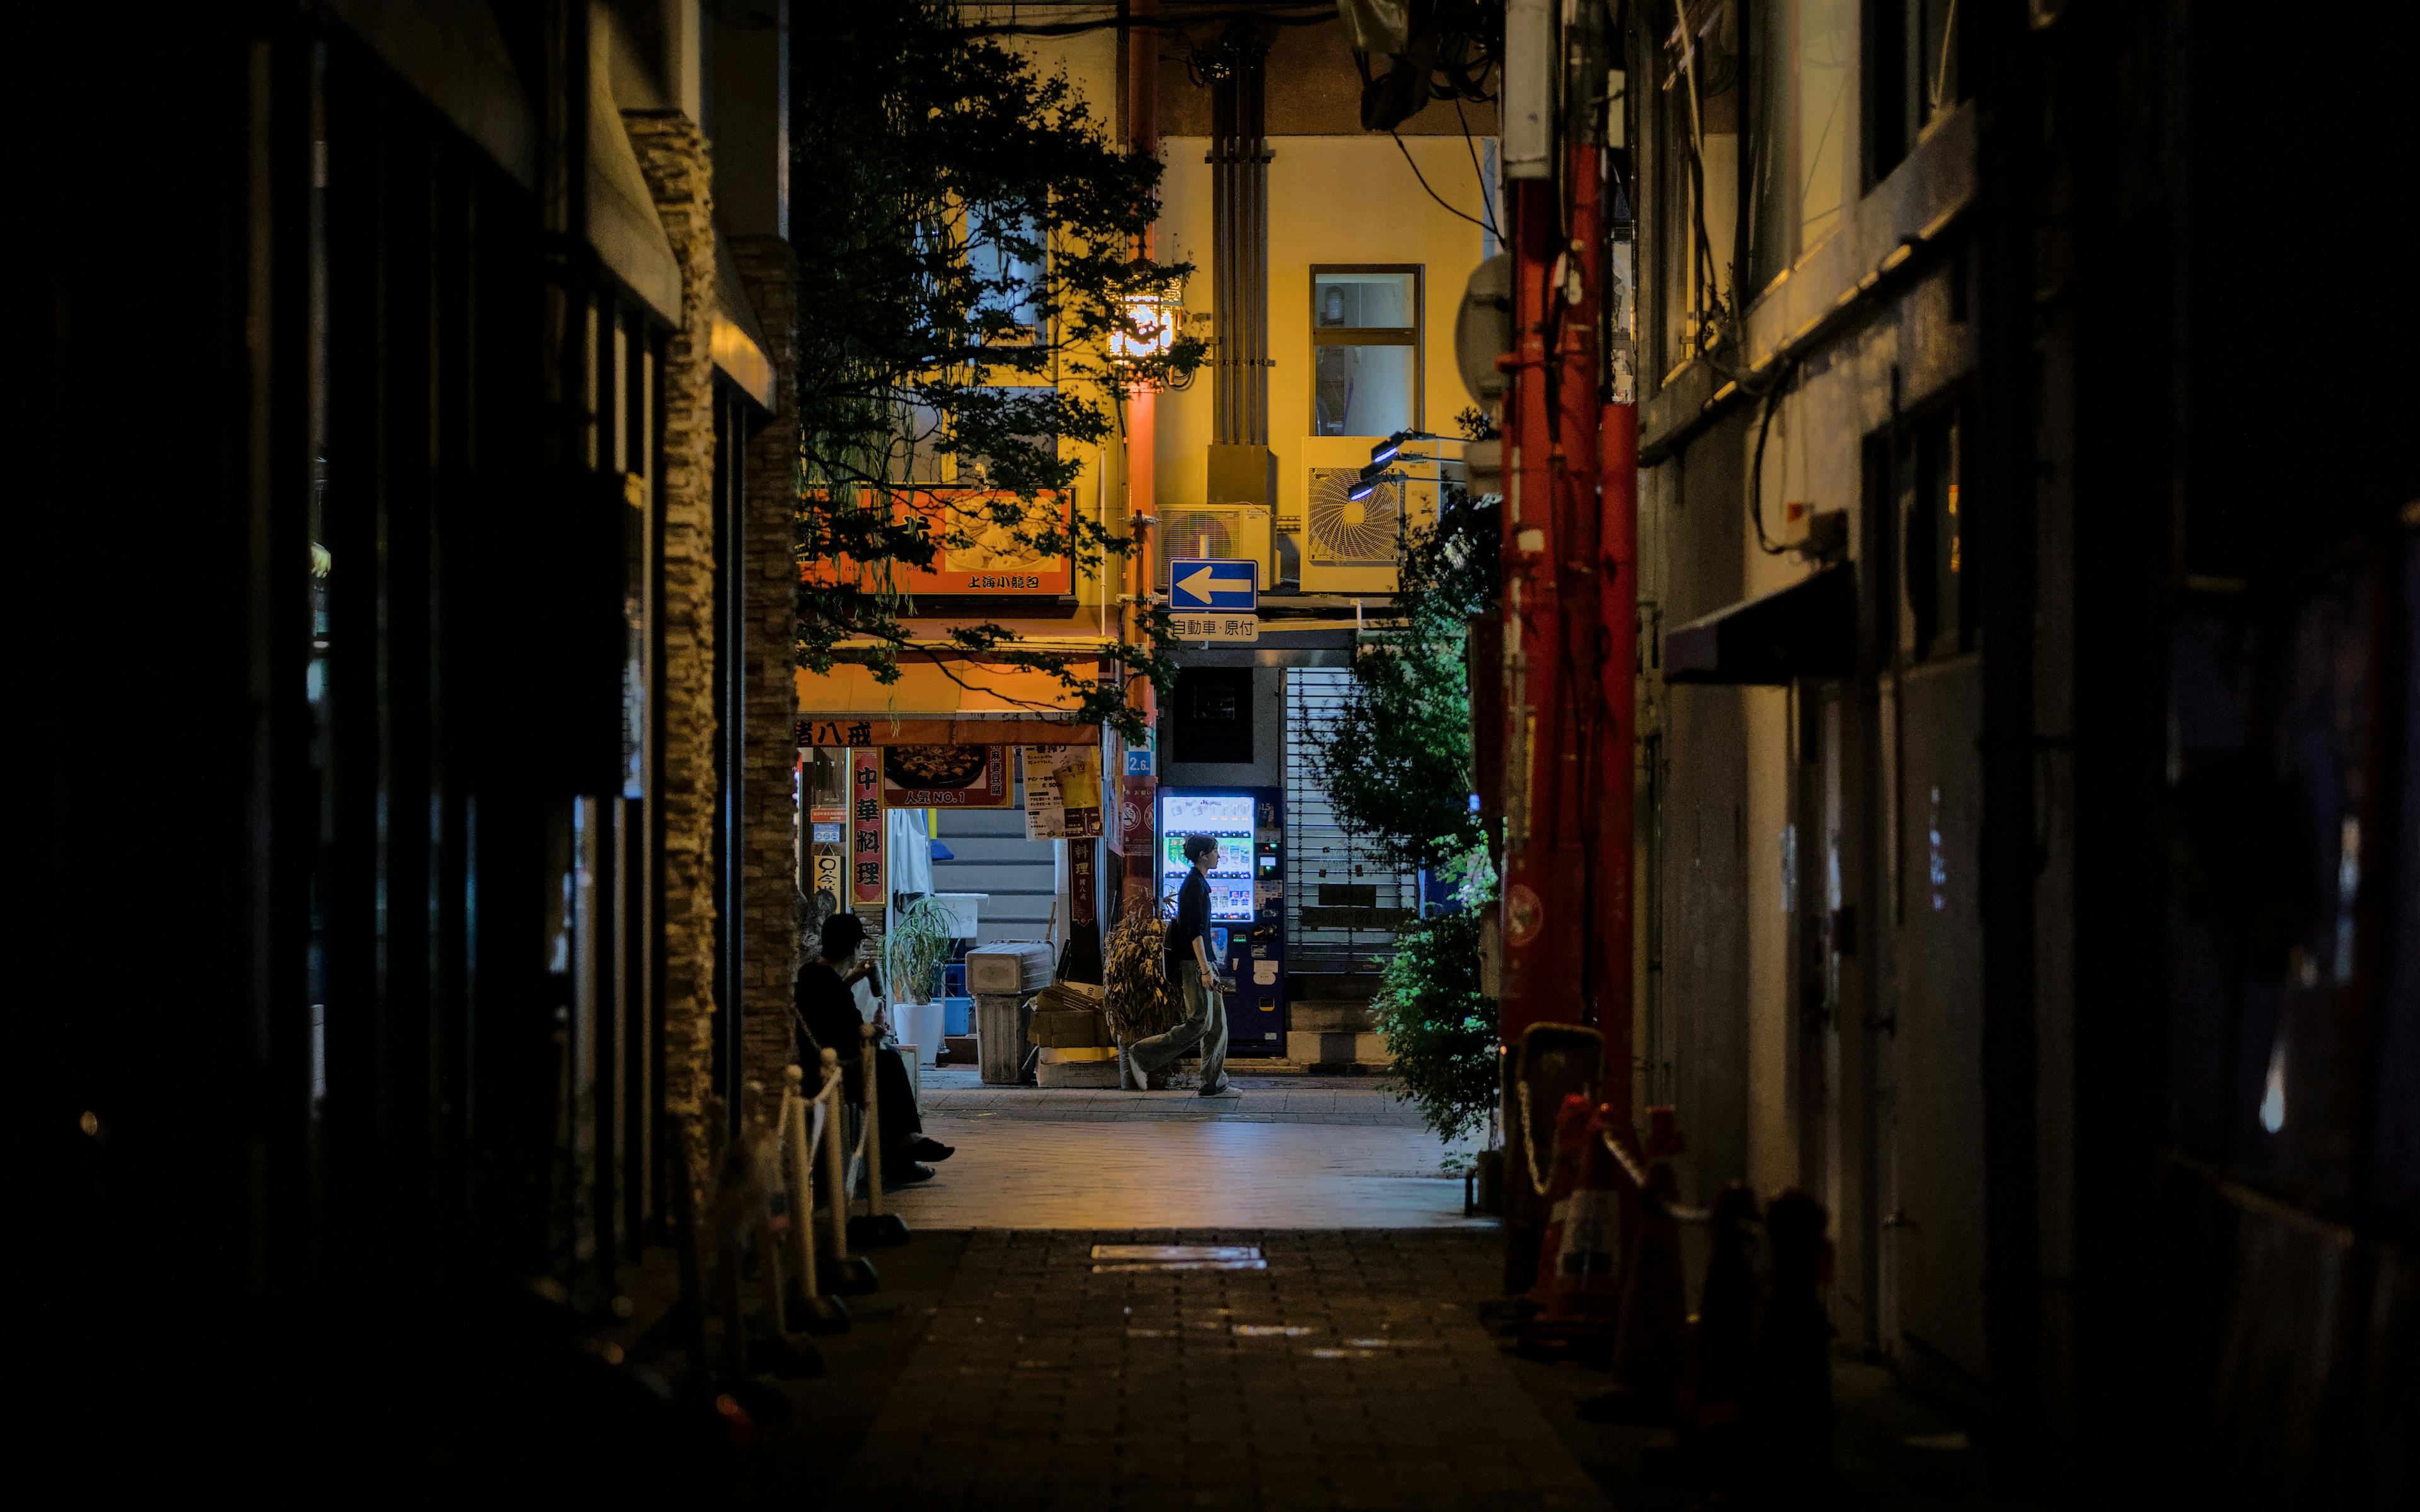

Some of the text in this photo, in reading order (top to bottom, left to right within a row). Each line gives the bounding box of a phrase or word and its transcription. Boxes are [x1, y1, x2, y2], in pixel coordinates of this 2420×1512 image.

[968, 576, 1039, 588] 上海小籠包
[856, 767, 880, 885] 中華料理
[818, 858, 837, 891] 只今
[1075, 840, 1090, 875] 料理
